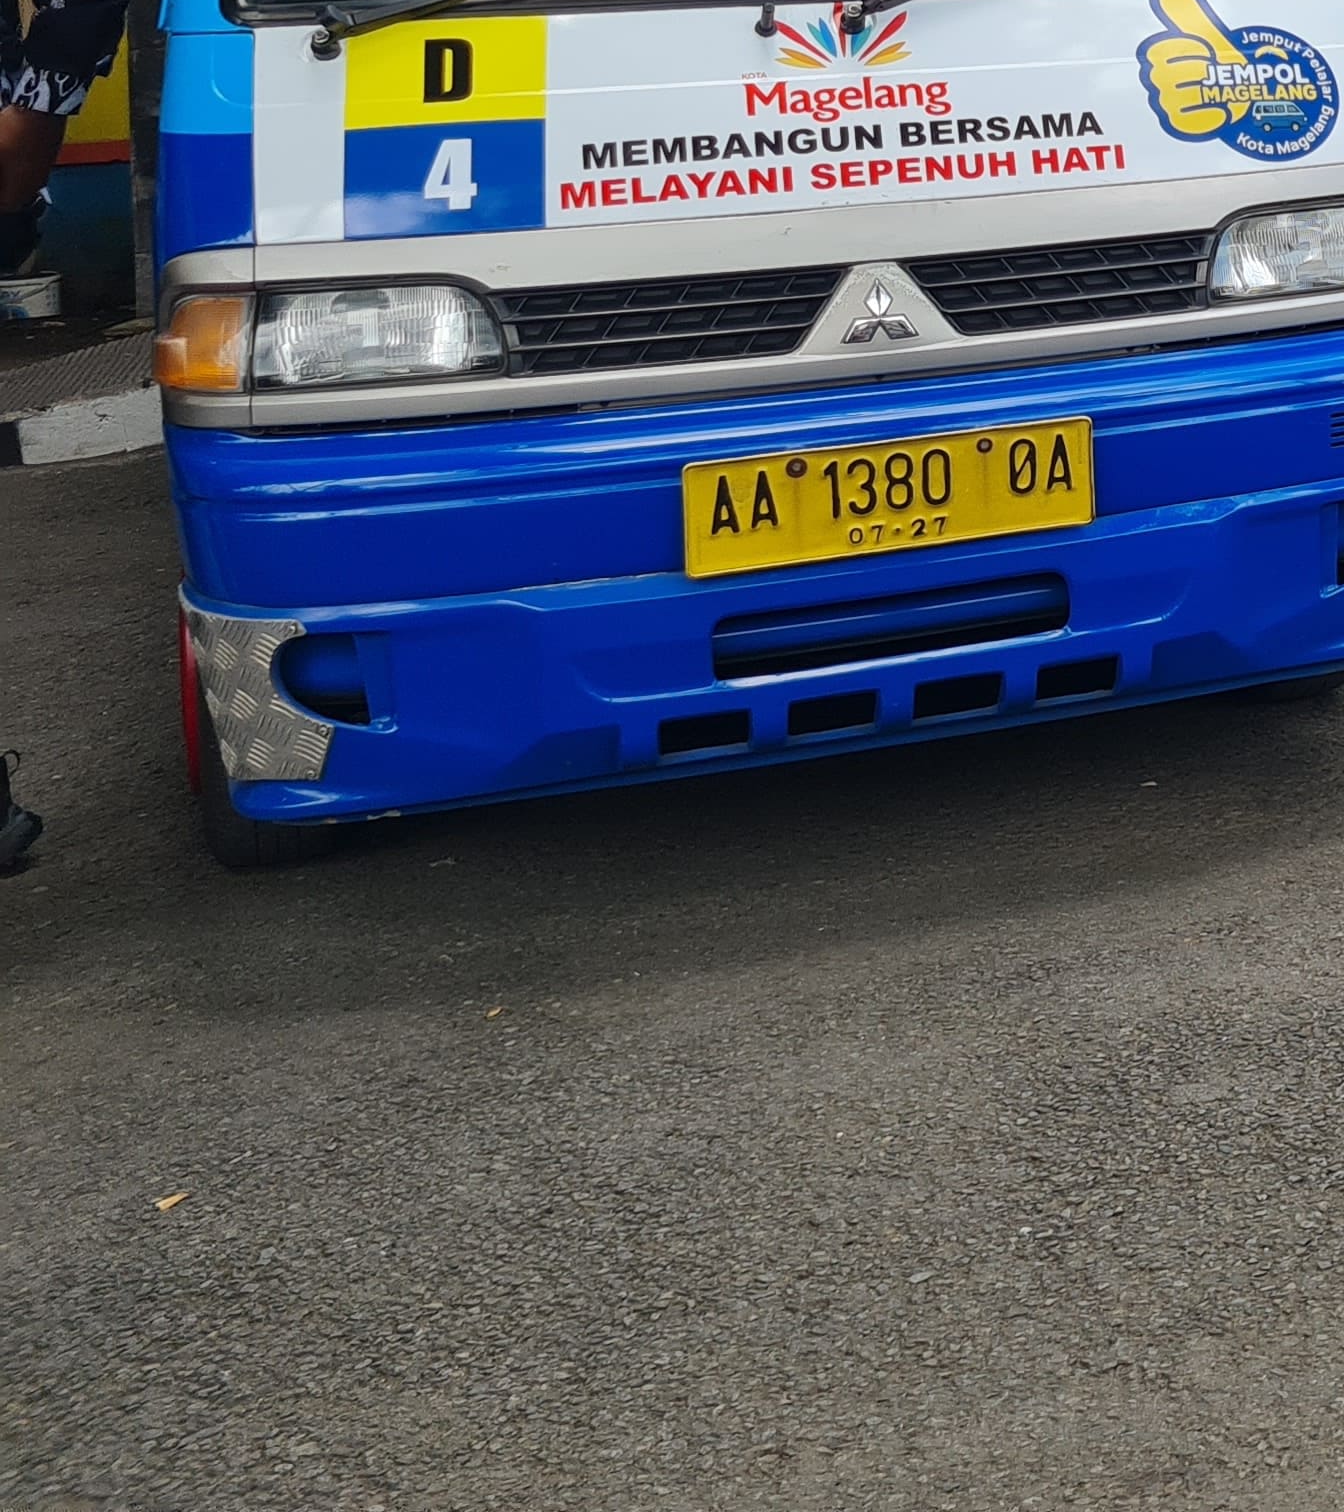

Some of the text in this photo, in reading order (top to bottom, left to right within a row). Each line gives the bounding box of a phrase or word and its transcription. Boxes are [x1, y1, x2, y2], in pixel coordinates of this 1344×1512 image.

[423, 38, 474, 103] D
[741, 72, 768, 80] KOTA
[1202, 63, 1310, 86] JEMPOL
[1202, 84, 1318, 104] MAGELANG
[1241, 30, 1333, 102] Jemput Pelajar
[743, 76, 952, 122] Magelang
[582, 111, 1104, 170] MEMBANGUN BERSAMA
[1237, 104, 1335, 155] Kota Magelang
[423, 138, 478, 210] 4
[560, 144, 1126, 209] MELAYANI SEPENUH HATI
[710, 470, 779, 536] AA
[822, 448, 953, 520] 1380
